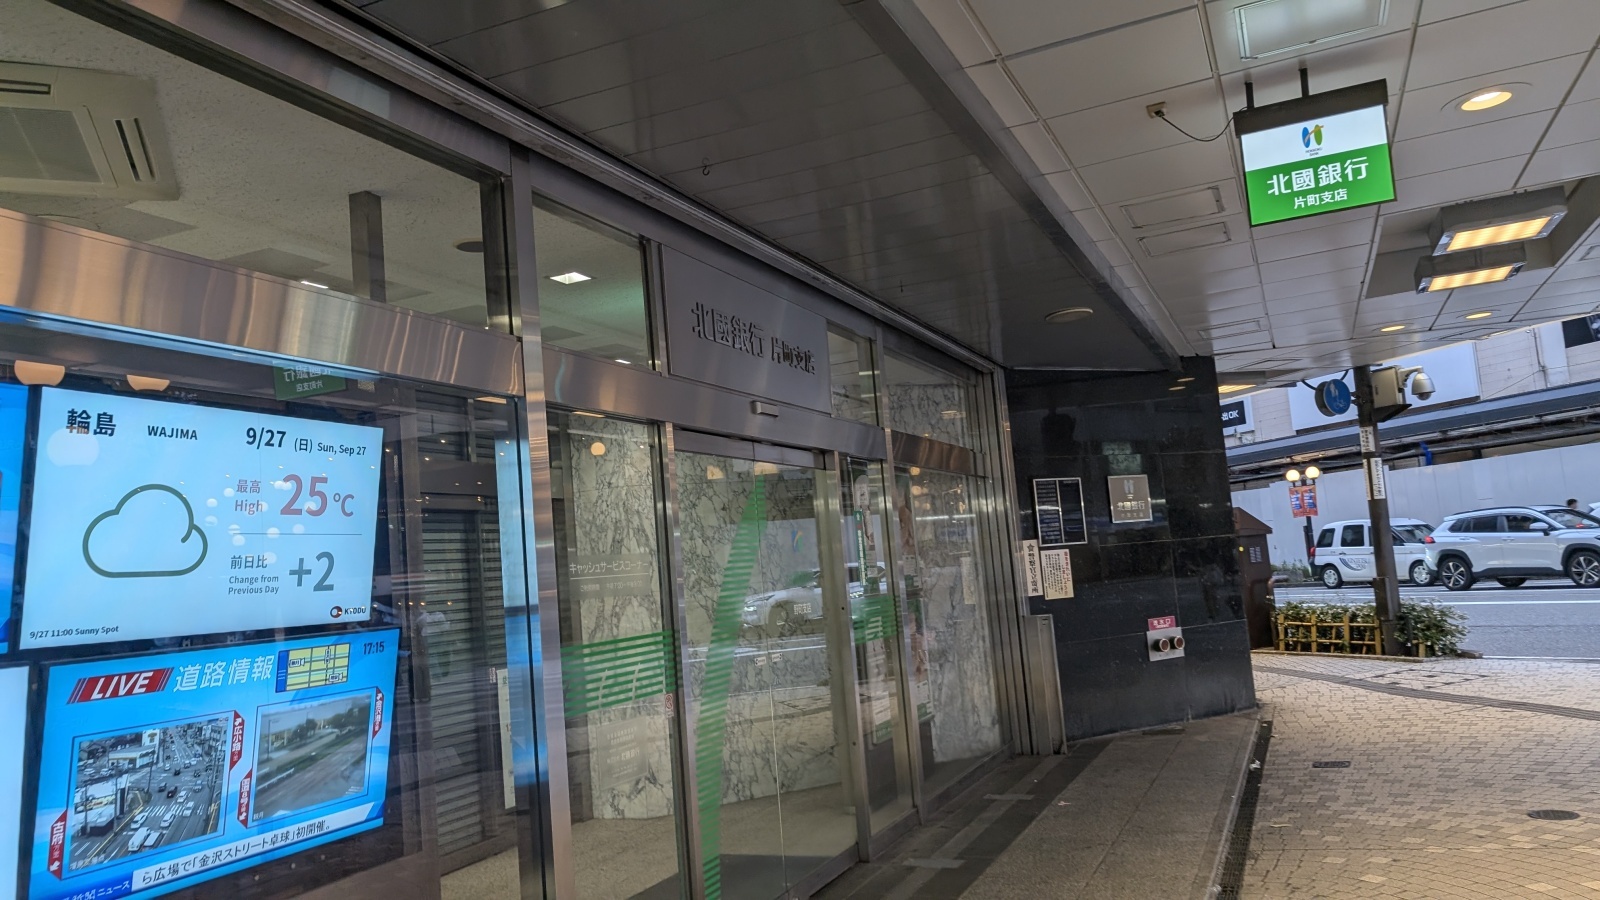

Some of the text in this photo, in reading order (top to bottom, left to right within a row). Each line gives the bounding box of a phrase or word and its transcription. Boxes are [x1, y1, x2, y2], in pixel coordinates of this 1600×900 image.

[1266, 156, 1369, 196] 北國銀行
[1293, 188, 1348, 209] 片町支店
[691, 302, 764, 358] 北國銀行
[770, 336, 816, 375] 片町支店
[66, 408, 117, 437] 輪島
[147, 424, 199, 440] WAJIMA
[245, 427, 366, 457] 9/27 (日) Sun, Sep 27
[236, 480, 261, 494] 最高
[234, 500, 264, 515] High
[230, 555, 268, 570] 前日比
[289, 551, 335, 592] +2
[569, 561, 649, 574] キャッシュサービスコーナー
[228, 574, 279, 585] Change from
[228, 584, 279, 596] Previous Day
[30, 625, 119, 640] 9/27 11:00 Sunny Spot
[363, 641, 385, 655] 17:15
[173, 655, 275, 693] 道路情報
[89, 672, 154, 700] LIVE
